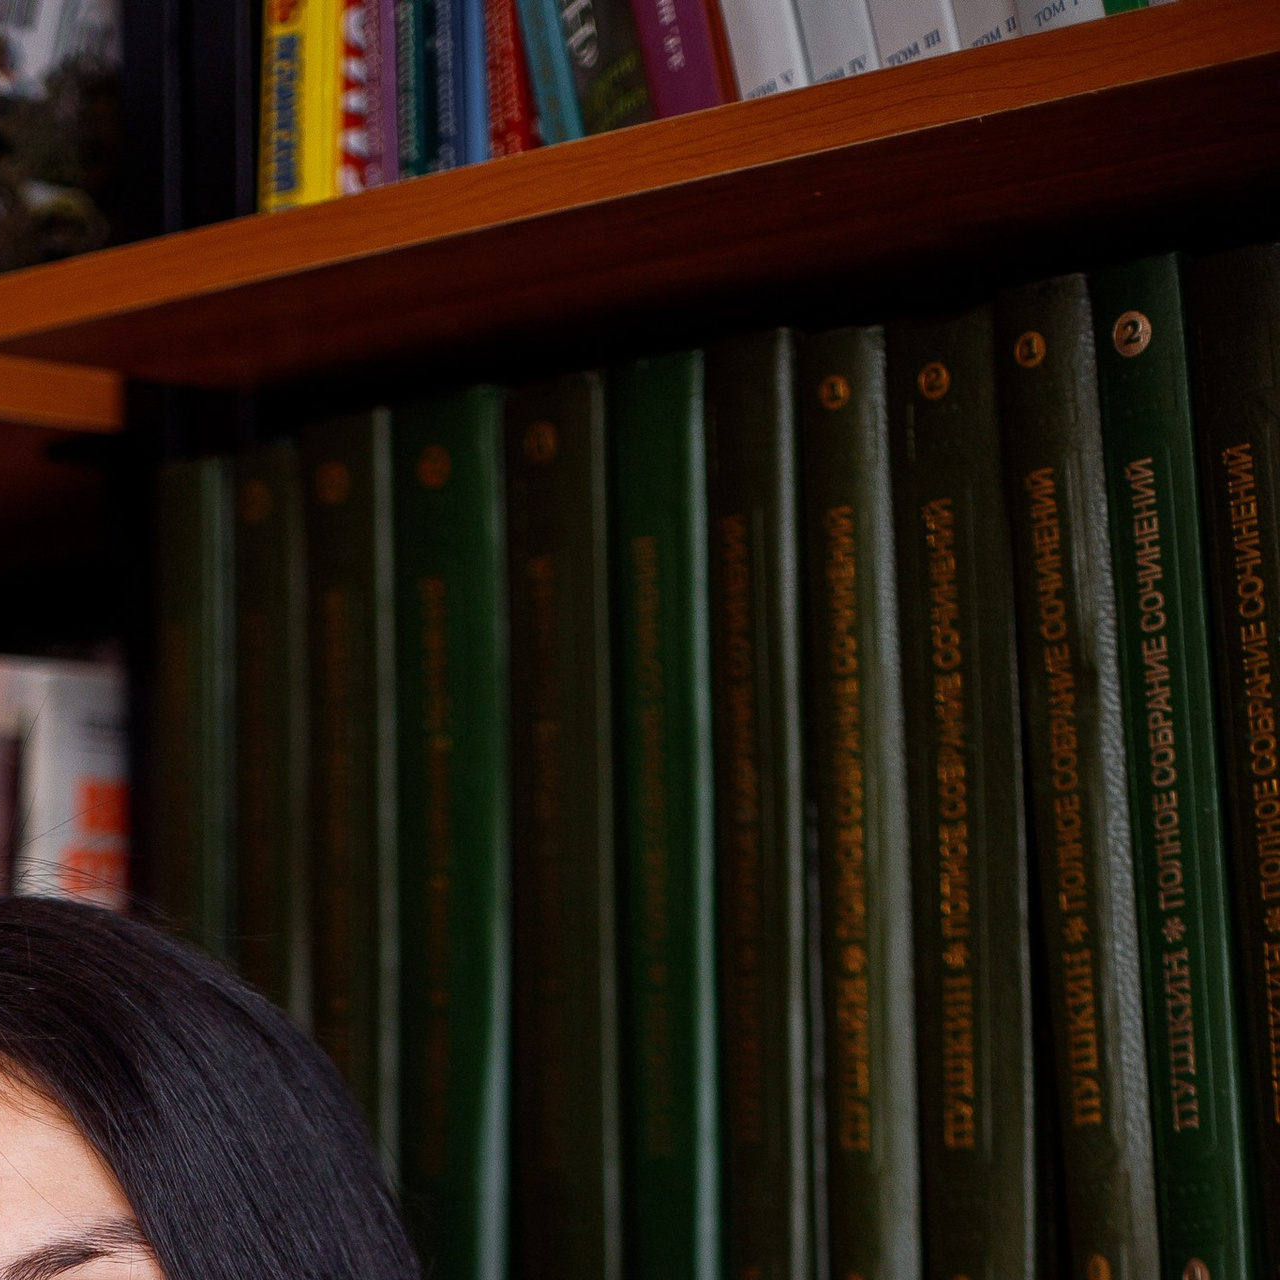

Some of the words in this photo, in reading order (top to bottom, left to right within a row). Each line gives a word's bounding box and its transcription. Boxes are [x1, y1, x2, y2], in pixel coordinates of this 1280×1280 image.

[886, 42, 920, 67] ТОМ
[1034, 0, 1067, 27] ТОМ
[923, 497, 960, 670] СОЧИНЕНИЙ
[1026, 466, 1067, 640] СОЧИНЕНИЙ
[1125, 455, 1166, 632] СОЧИНЕНИЙ
[1222, 442, 1267, 618] СОЧИНЕНИЙ
[1044, 643, 1080, 791] СОБРАНИЕ
[1142, 635, 1178, 788] СОБРАНИЕ
[1240, 620, 1280, 776] СОБРАНИЕ
[1054, 794, 1089, 912] ПОЛНОЕ
[1152, 790, 1186, 909] ПОЛНОЕ
[1251, 777, 1280, 900] ПОЛНОЕ
[1063, 949, 1103, 1126] ПУШКИН
[1164, 948, 1201, 1131] ПУШКИН
